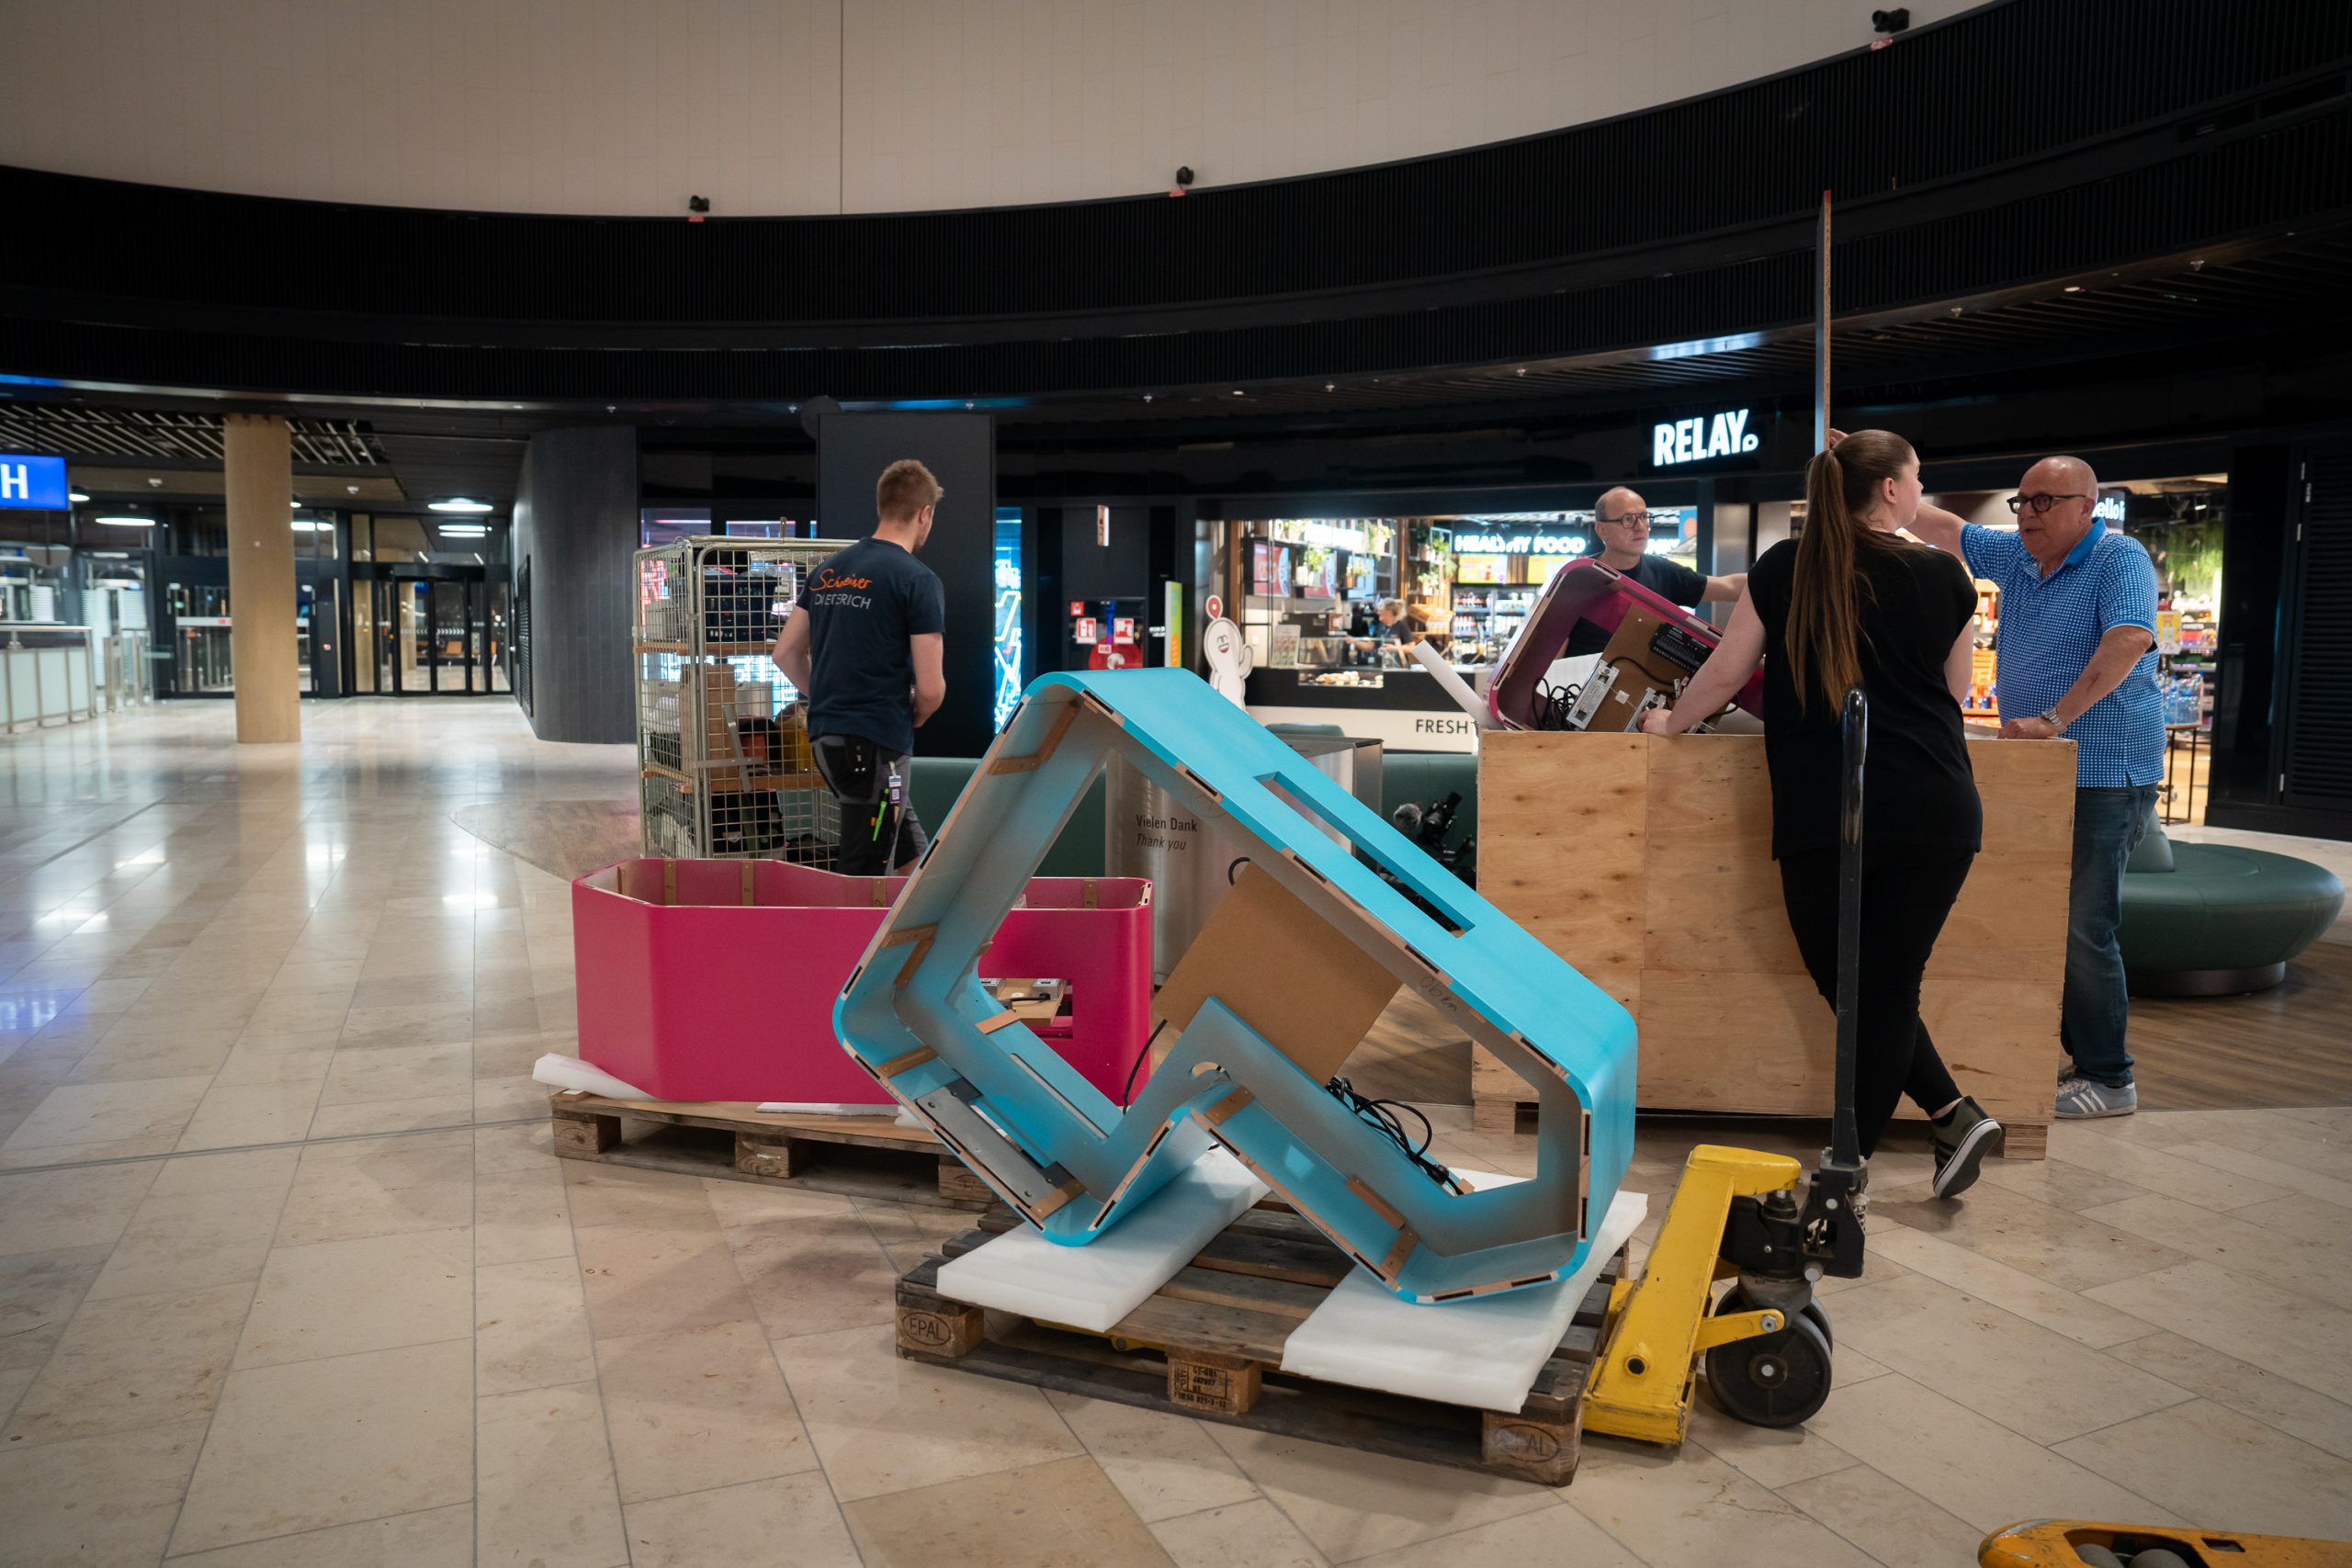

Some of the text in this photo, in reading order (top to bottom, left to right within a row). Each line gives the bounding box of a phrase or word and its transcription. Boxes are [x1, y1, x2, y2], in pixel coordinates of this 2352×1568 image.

[0, 463, 28, 500] H
[1533, 536, 1586, 554] FOOD
[1416, 719, 1468, 734] FRESH
[1136, 815, 1197, 831] Vielen Dank
[1136, 833, 1187, 852] Thank you
[909, 1317, 944, 1342] EPAL
